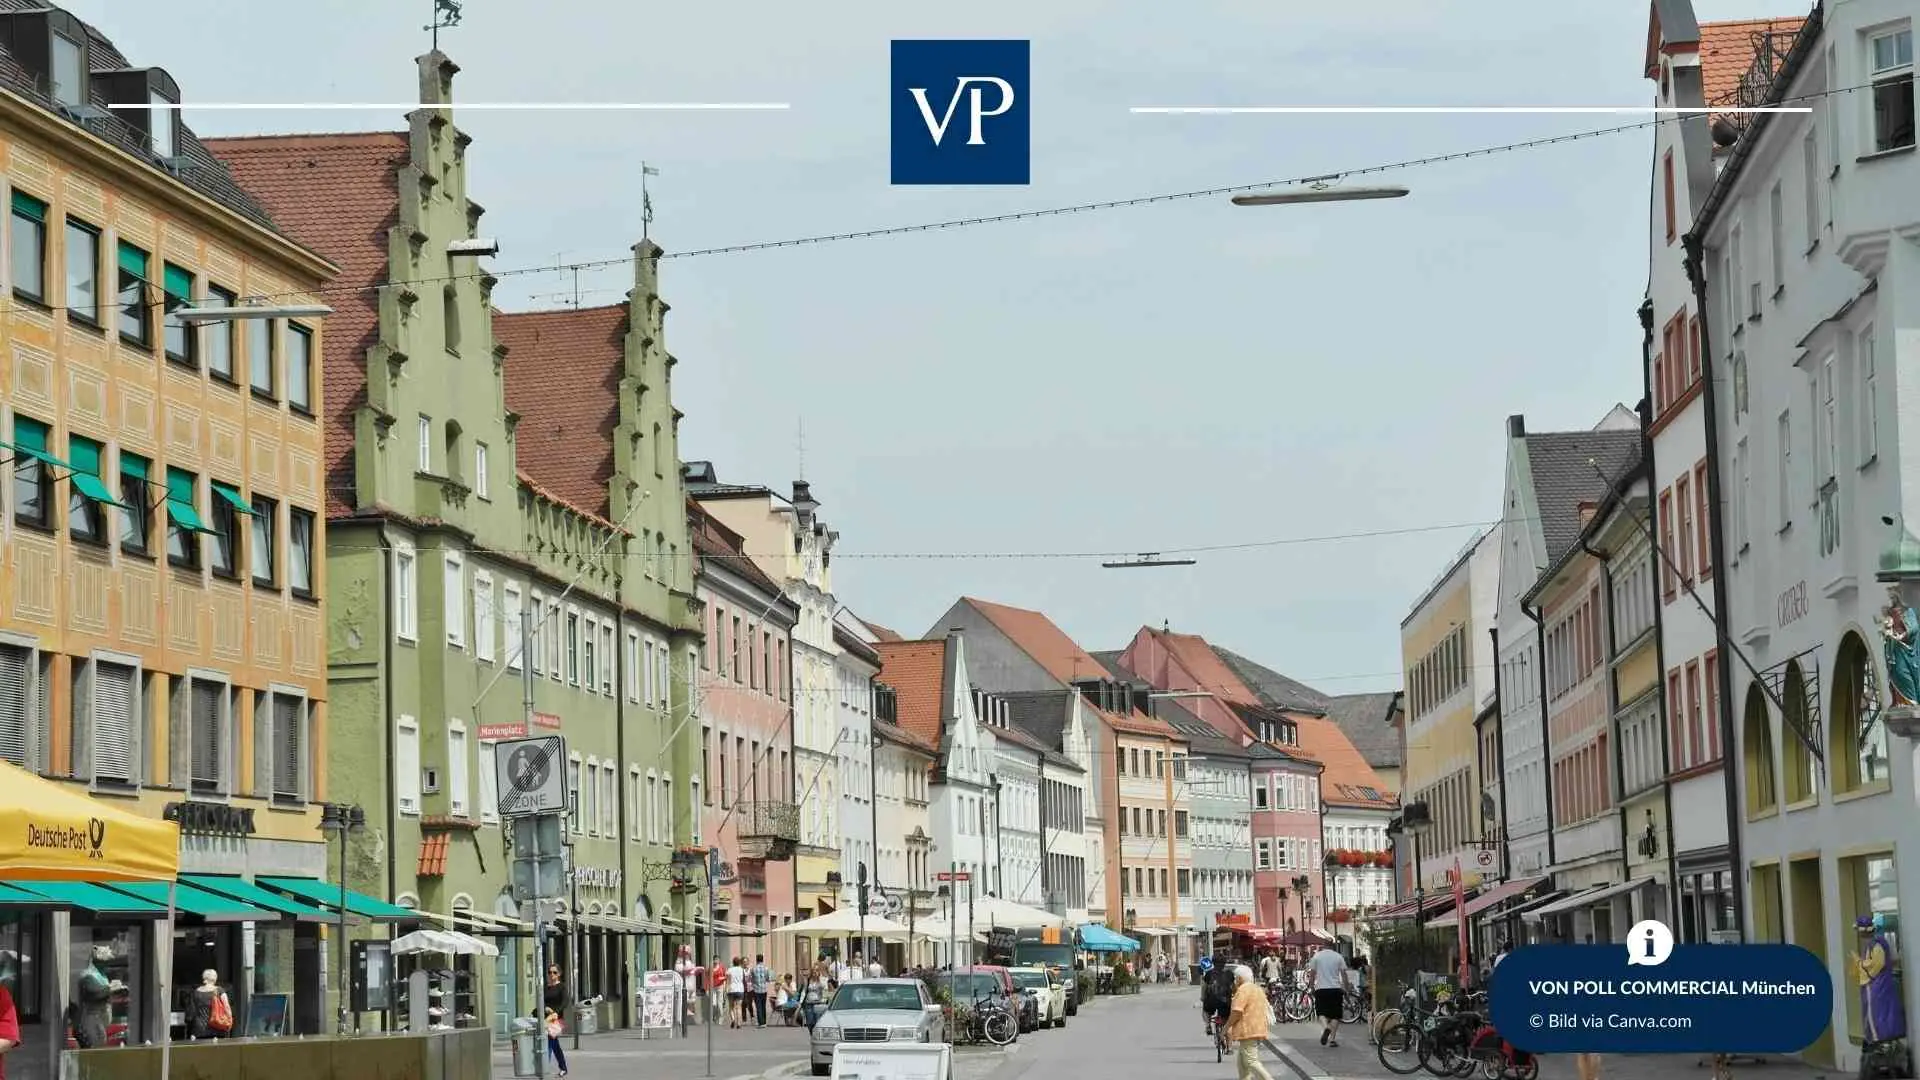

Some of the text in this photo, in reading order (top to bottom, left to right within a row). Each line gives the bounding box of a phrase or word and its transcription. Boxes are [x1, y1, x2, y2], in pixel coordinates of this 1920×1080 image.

[514, 793, 548, 809] ZONE
[28, 823, 87, 850] Deutsche Post
